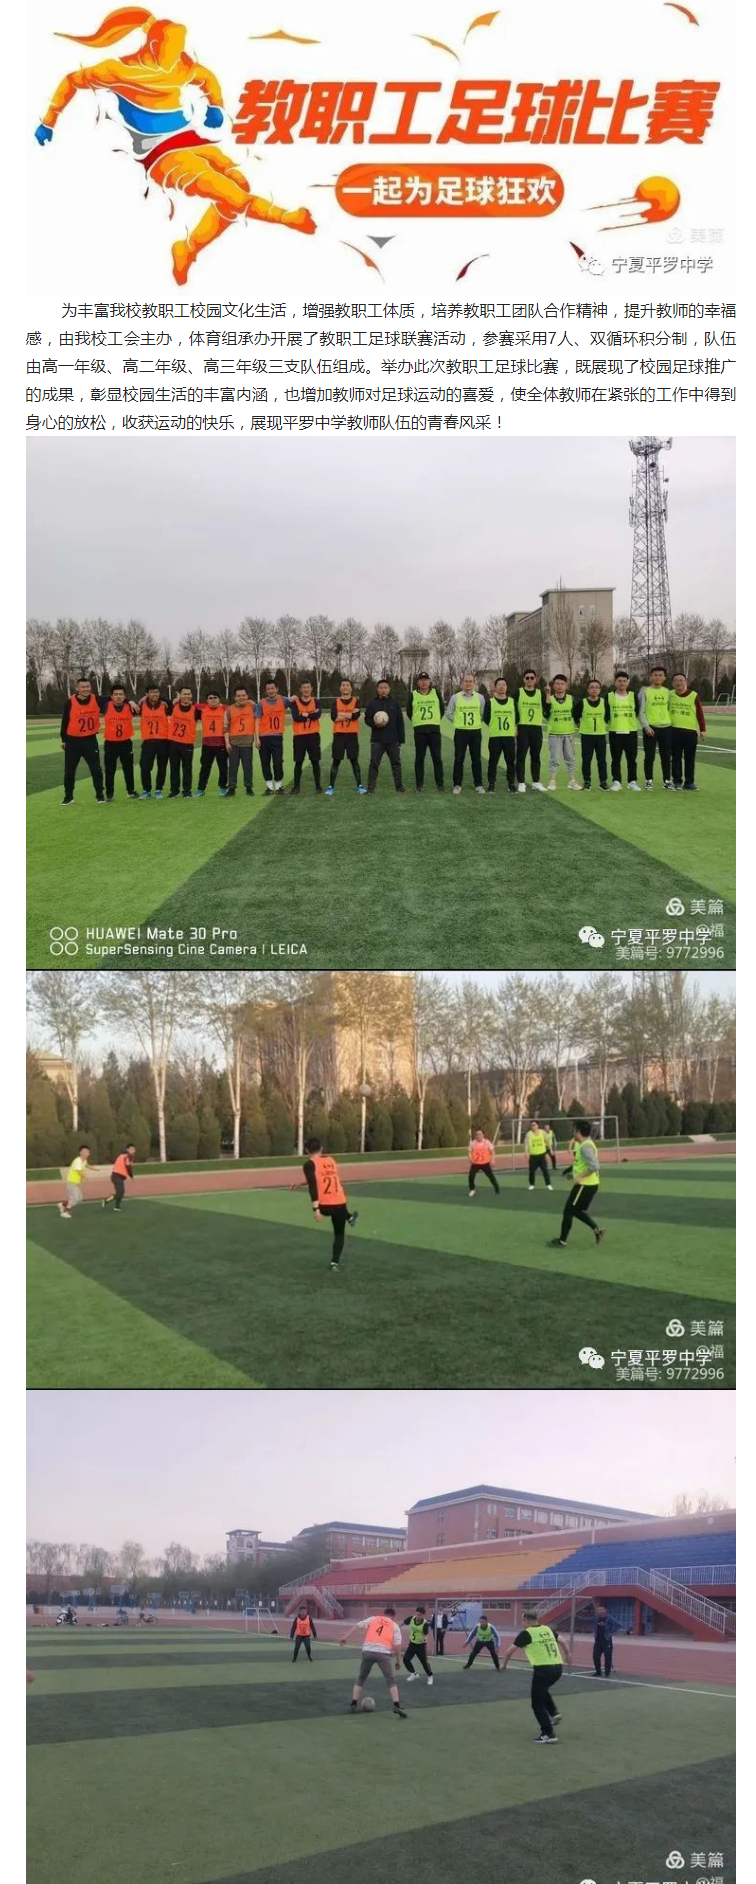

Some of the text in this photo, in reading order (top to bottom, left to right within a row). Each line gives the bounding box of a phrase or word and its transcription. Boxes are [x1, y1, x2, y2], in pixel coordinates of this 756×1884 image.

[231, 79, 720, 144] 教职工足球比赛
[342, 176, 557, 206] 一起为足球狂欢
[62, 302, 736, 318] 为丰富我校教职工校园文化生活，增强教职工体质，培养教职工团队合作精神，提升教师的幸福
[26, 330, 736, 347] 感，由我校工会主办，体育组承办开展了教职工足球联赛活动，参赛采用7人、双循环积分制，队伍
[27, 358, 736, 374] 由高一年级、高二年级、高三年级三支队伍组成。举办此次教职工足球比赛，既展现了校园足球推广
[26, 386, 735, 402] 的成果，彰显校园生活的丰富内涵，也增加教师对足球运动的喜爱，使全体教师在紧张的工作中得到
[26, 414, 500, 430] 身心的放松，收获运动的快乐，展现平罗中学教师队伍的青春风采！
[420, 706, 433, 720] 25
[463, 712, 474, 726] 13
[528, 708, 535, 722] 9
[78, 717, 95, 732] 20
[172, 723, 187, 737] 23
[209, 719, 216, 733] 4
[239, 718, 245, 732] 5
[269, 716, 280, 730] 10
[498, 717, 510, 731] 16
[116, 724, 123, 737] 8
[323, 1176, 338, 1194] 21
[376, 1625, 384, 1636] 4
[544, 1643, 558, 1658] 19
